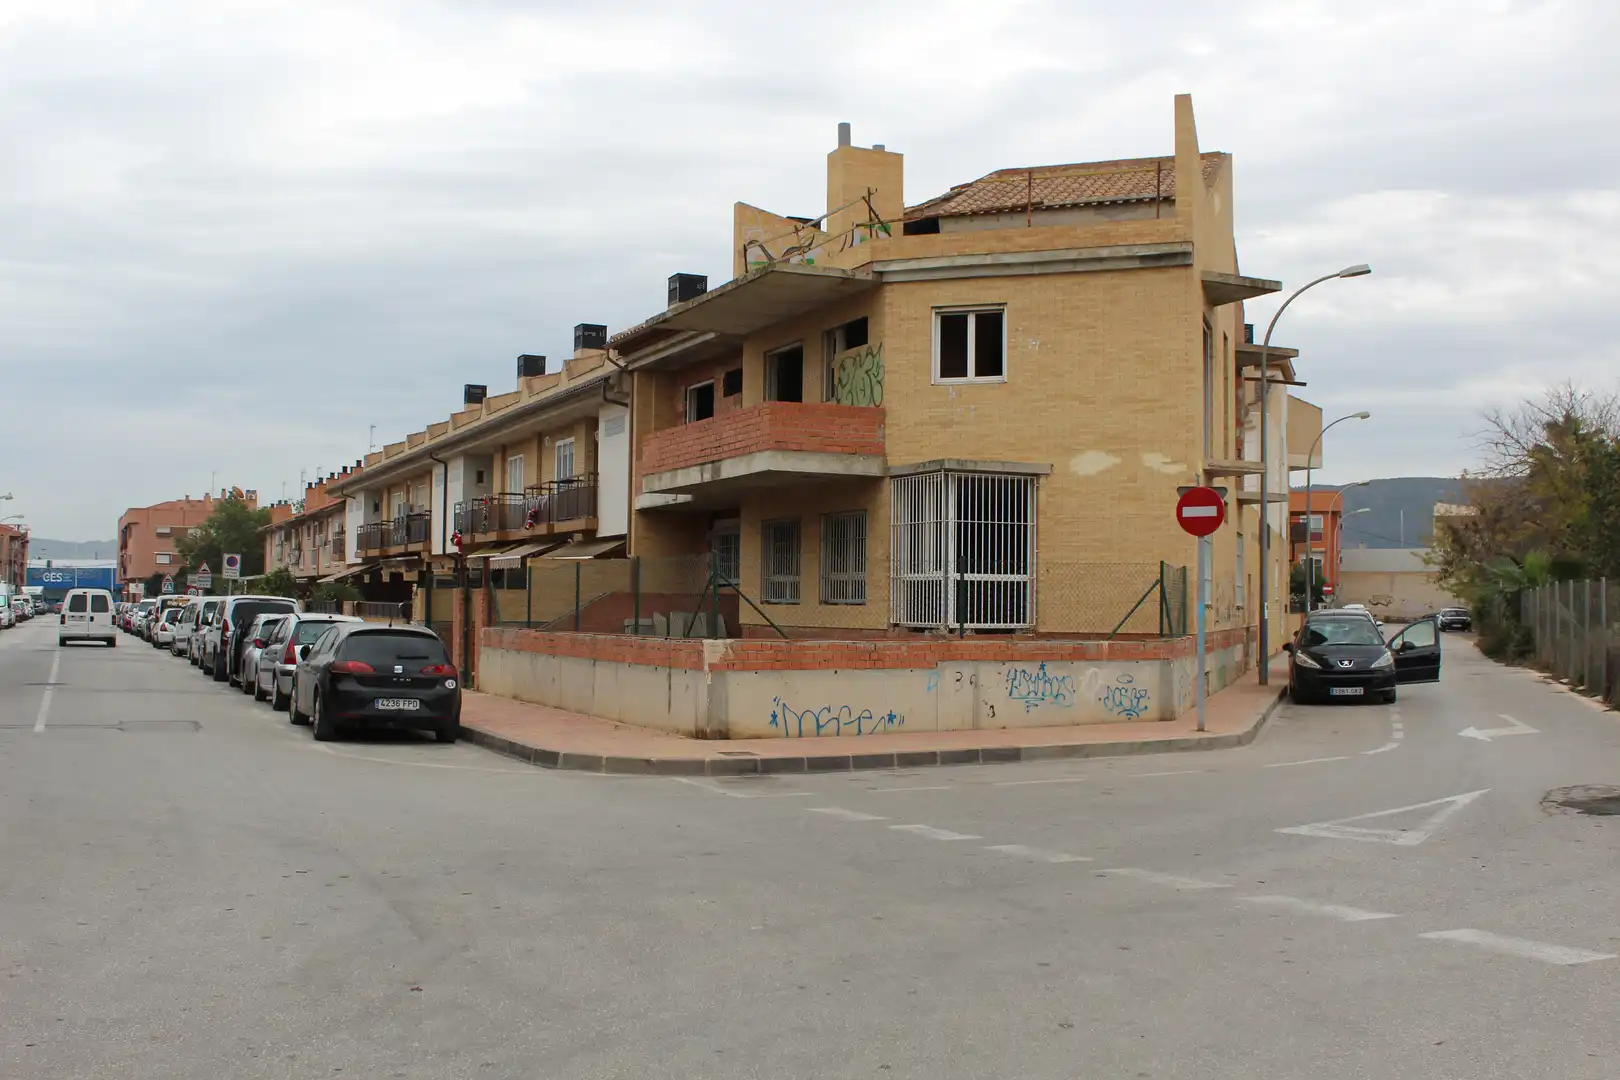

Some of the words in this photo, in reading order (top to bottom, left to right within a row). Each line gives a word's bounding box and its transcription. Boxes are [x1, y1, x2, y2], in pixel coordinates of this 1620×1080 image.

[43, 572, 63, 582] CES
[380, 699, 401, 707] 4236
[403, 700, 418, 708] FPD
